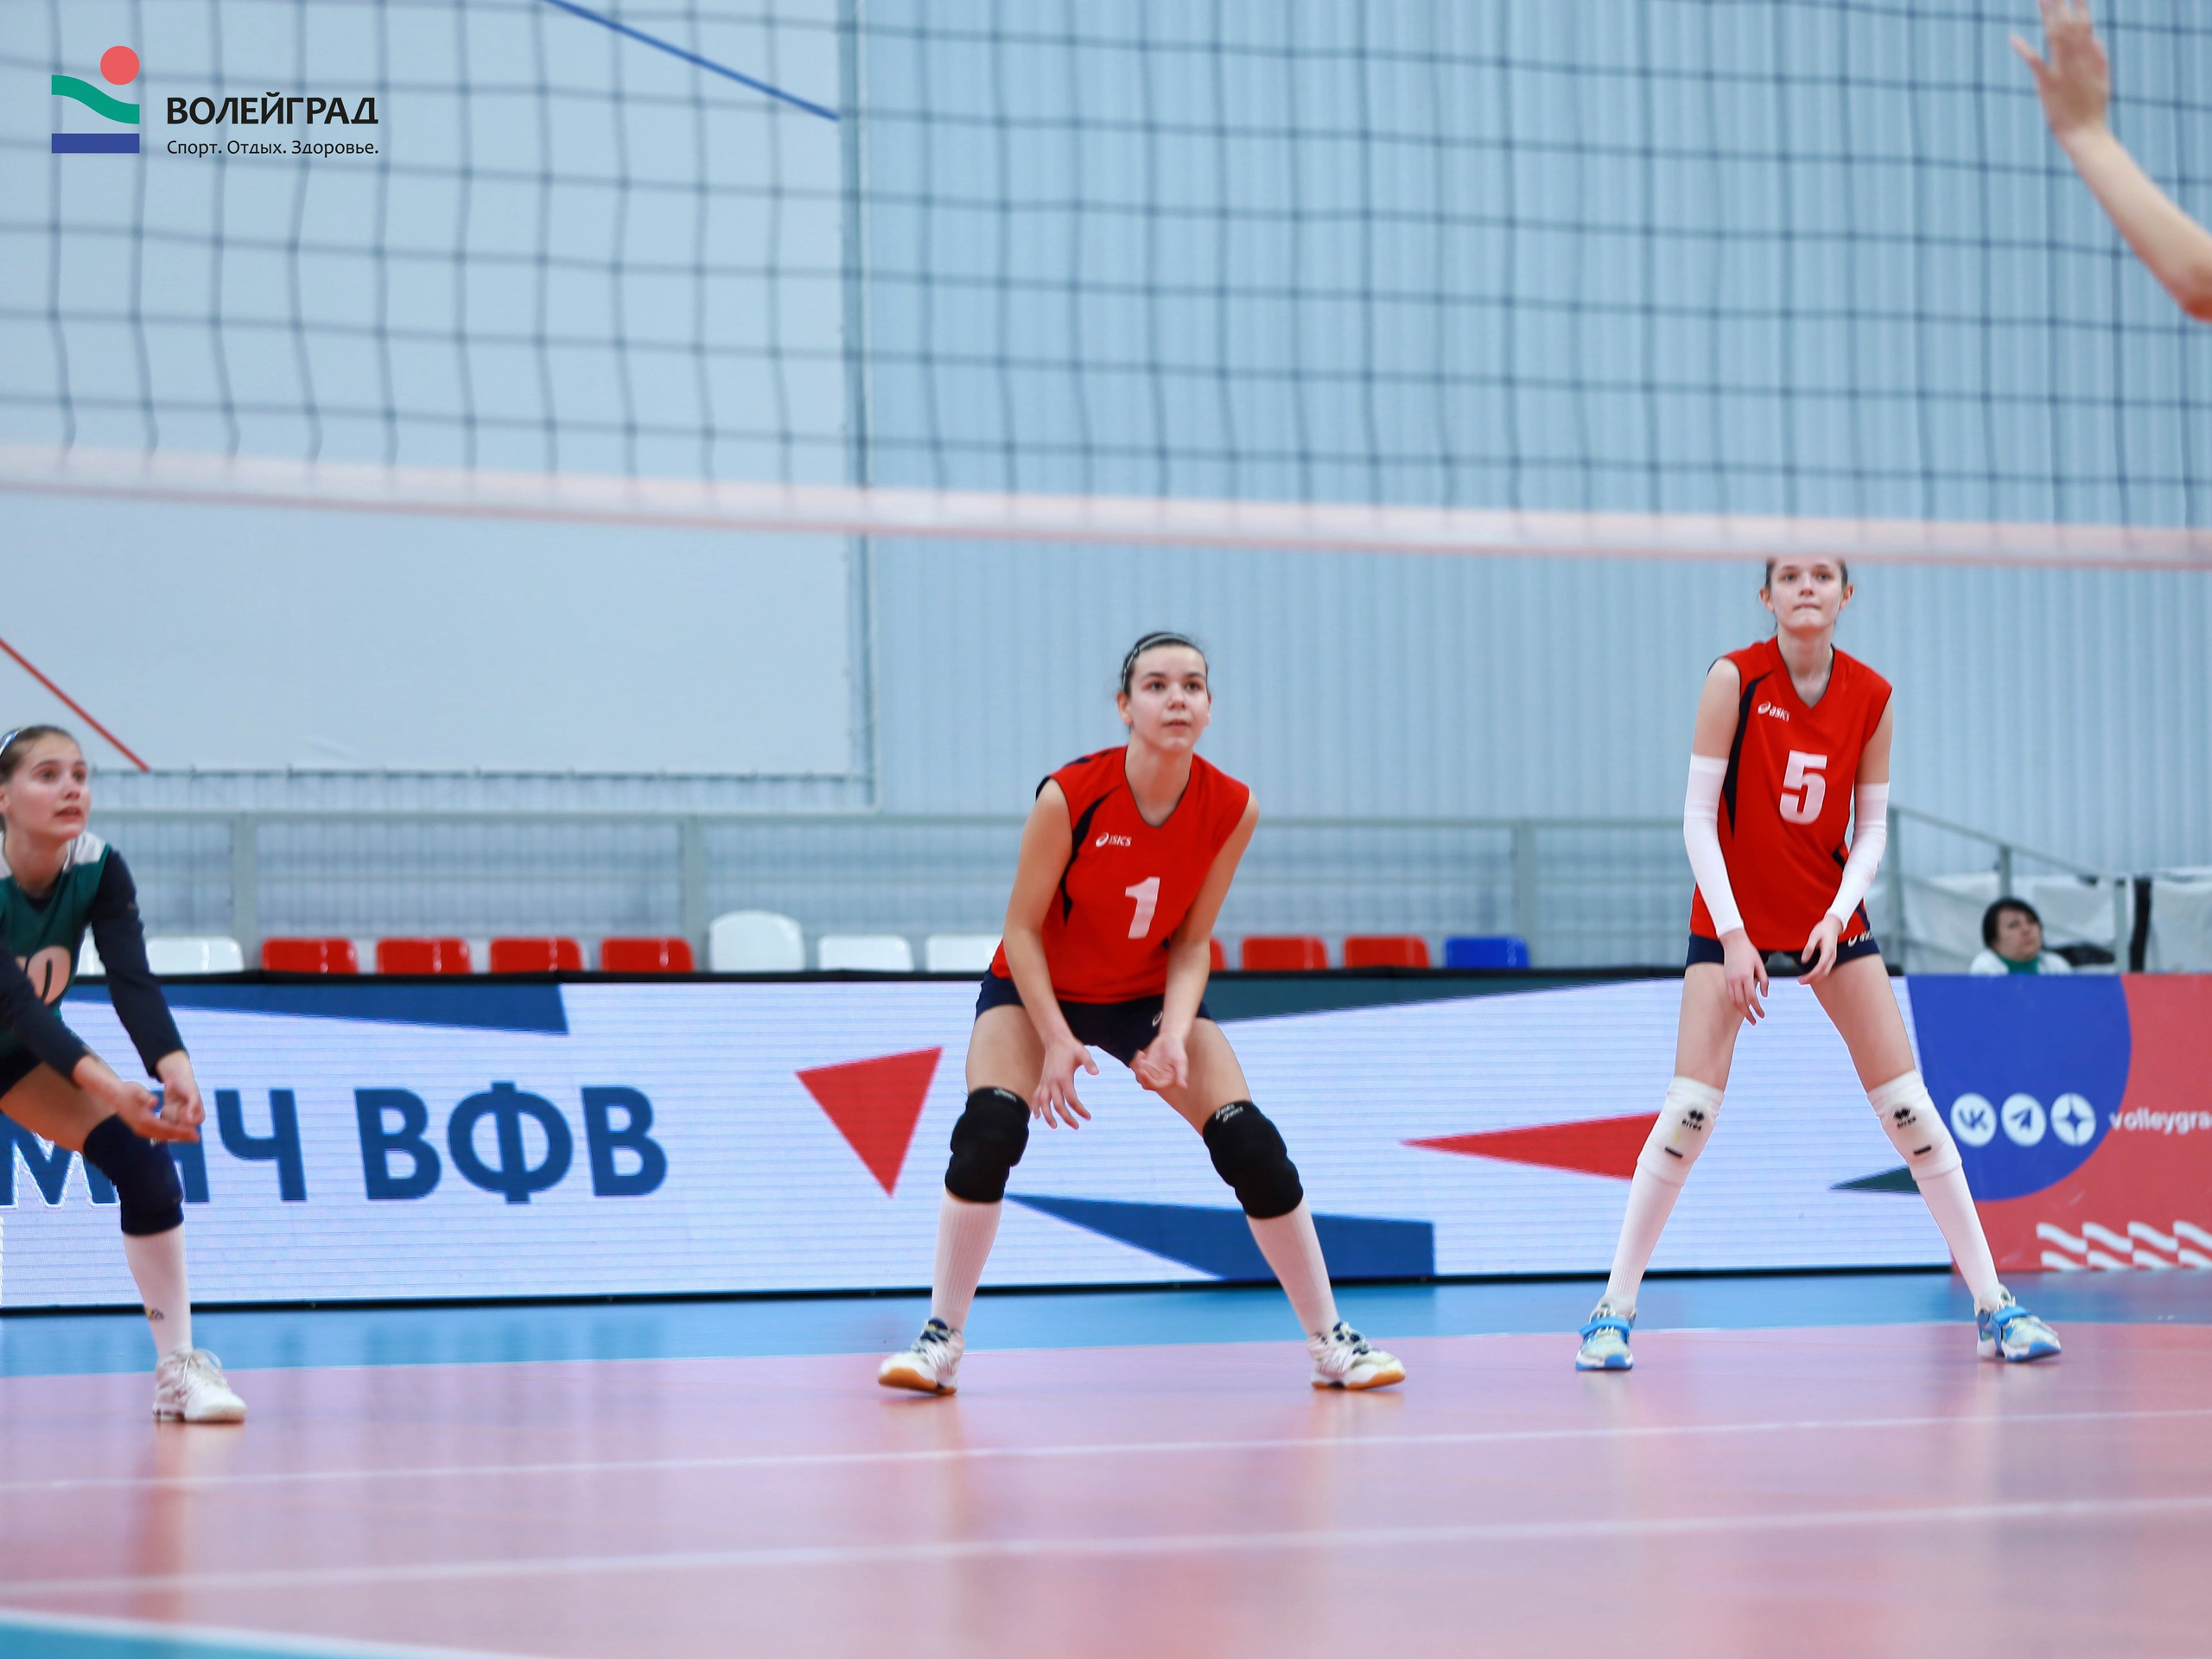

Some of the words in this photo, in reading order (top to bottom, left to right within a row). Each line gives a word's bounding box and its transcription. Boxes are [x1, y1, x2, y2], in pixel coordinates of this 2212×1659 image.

[1779, 749, 1827, 825] 5
[1125, 876, 1160, 939] 1
[16, 944, 72, 1006] 0
[354, 1082, 668, 1204] ВФВ
[2108, 1107, 2212, 1135] volleygra
